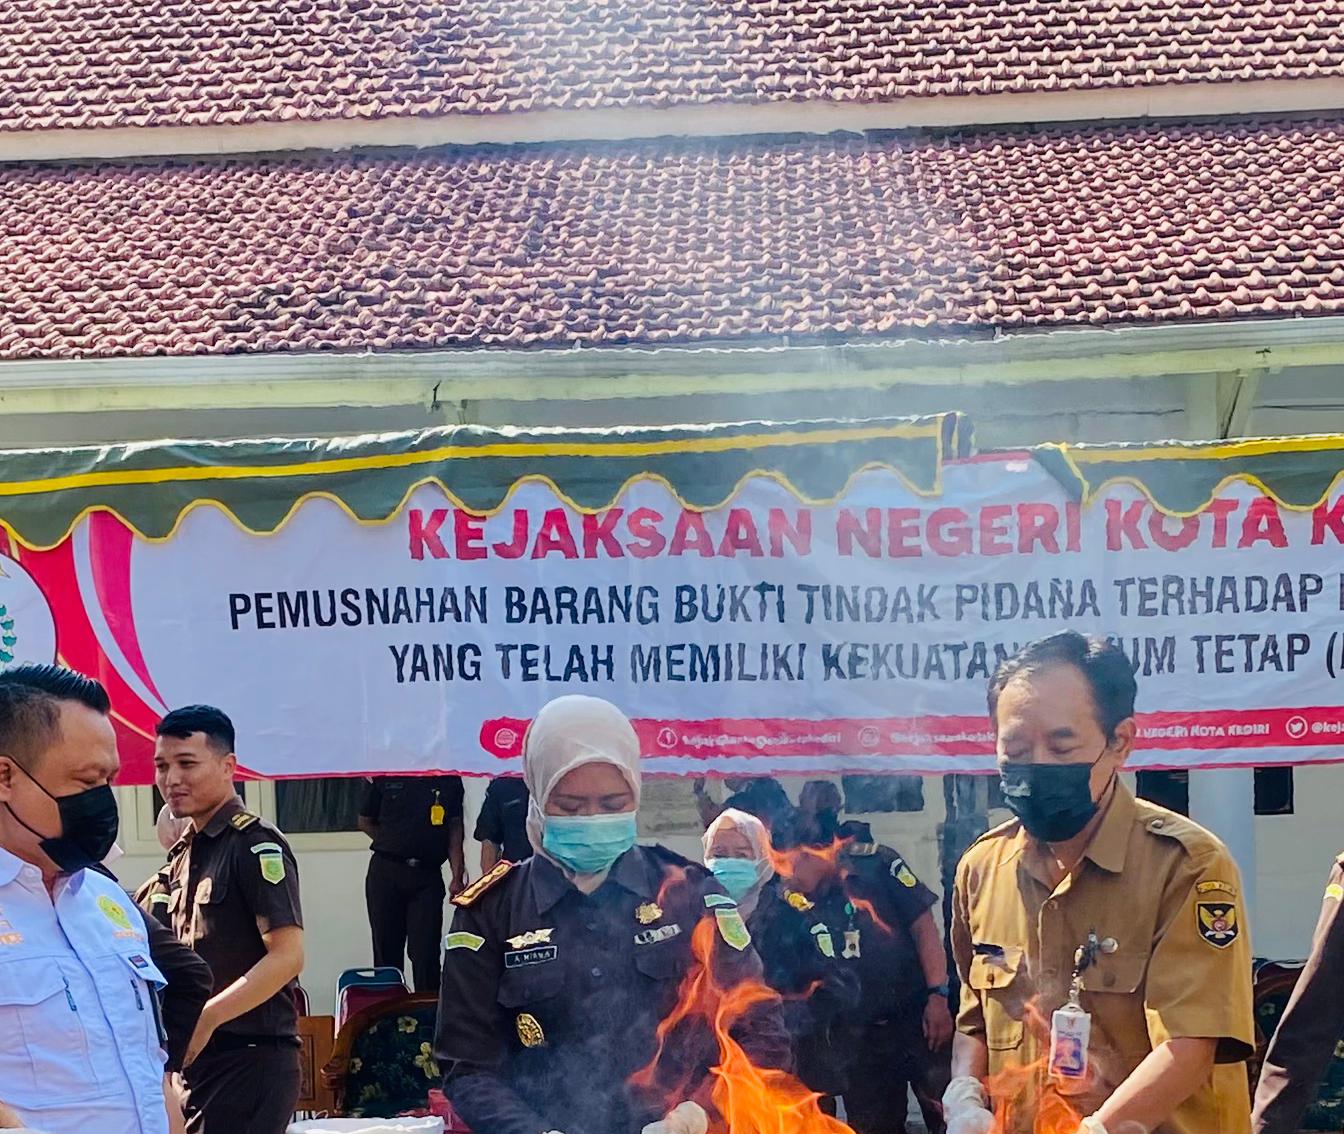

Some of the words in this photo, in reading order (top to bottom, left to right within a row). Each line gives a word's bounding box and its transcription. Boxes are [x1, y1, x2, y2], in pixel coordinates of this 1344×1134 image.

[409, 506, 812, 560] KEJAKSAAN
[836, 501, 1082, 558] NEGERI
[1105, 497, 1289, 551] KOTA
[229, 585, 488, 630] PEMUSNAHAN
[505, 585, 659, 625] BARANG
[674, 581, 785, 625] BUKTI
[797, 583, 941, 624] TINDAK
[955, 578, 1101, 622] PIDANA
[1113, 572, 1323, 617] TERHADAP
[388, 643, 482, 683] YANG
[495, 642, 615, 682] TELAH
[631, 641, 806, 683] MEMILIKI
[1191, 632, 1311, 674] TETAP
